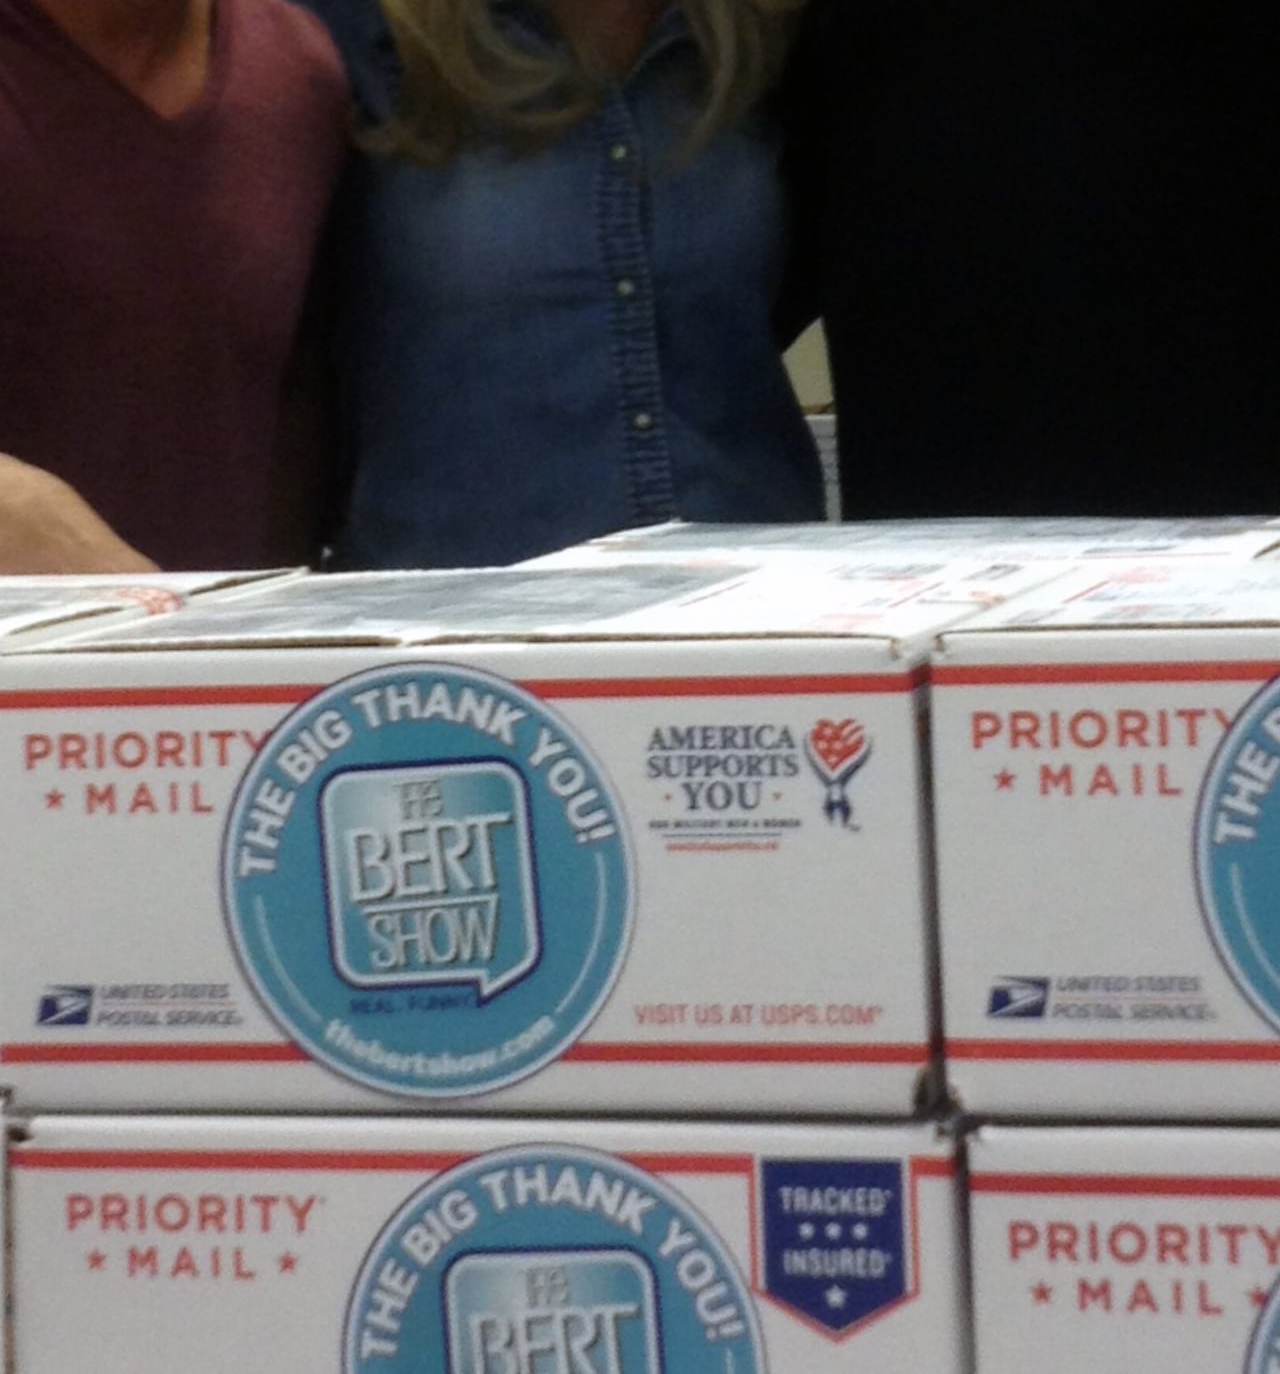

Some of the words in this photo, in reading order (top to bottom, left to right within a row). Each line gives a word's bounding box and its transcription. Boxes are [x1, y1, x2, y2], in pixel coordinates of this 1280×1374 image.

[646, 725, 796, 752] AMERICA
[239, 781, 295, 879] THE
[278, 710, 354, 786] BIG
[352, 681, 529, 747] THANK
[528, 727, 617, 845] YOU!
[646, 753, 800, 779] SUPPORTS
[1038, 762, 1183, 797] MAIL
[84, 781, 215, 815] MAIL
[681, 780, 764, 811] YOU
[348, 811, 514, 904] BERT
[367, 896, 499, 970] SHOW
[634, 1004, 686, 1025] VISIT
[694, 1004, 722, 1025] US
[729, 1004, 754, 1025] AT
[65, 1192, 318, 1234] PRIORITY
[779, 1186, 888, 1217] TRACKED
[127, 1244, 257, 1281] MAIL
[360, 1258, 418, 1361] THE
[399, 1188, 479, 1268] BIG
[475, 1163, 659, 1236] THANK
[657, 1219, 747, 1340] YOU!
[782, 1247, 888, 1279] INSURED
[1076, 1278, 1224, 1318] MAIL
[467, 1302, 639, 1374] BERT
